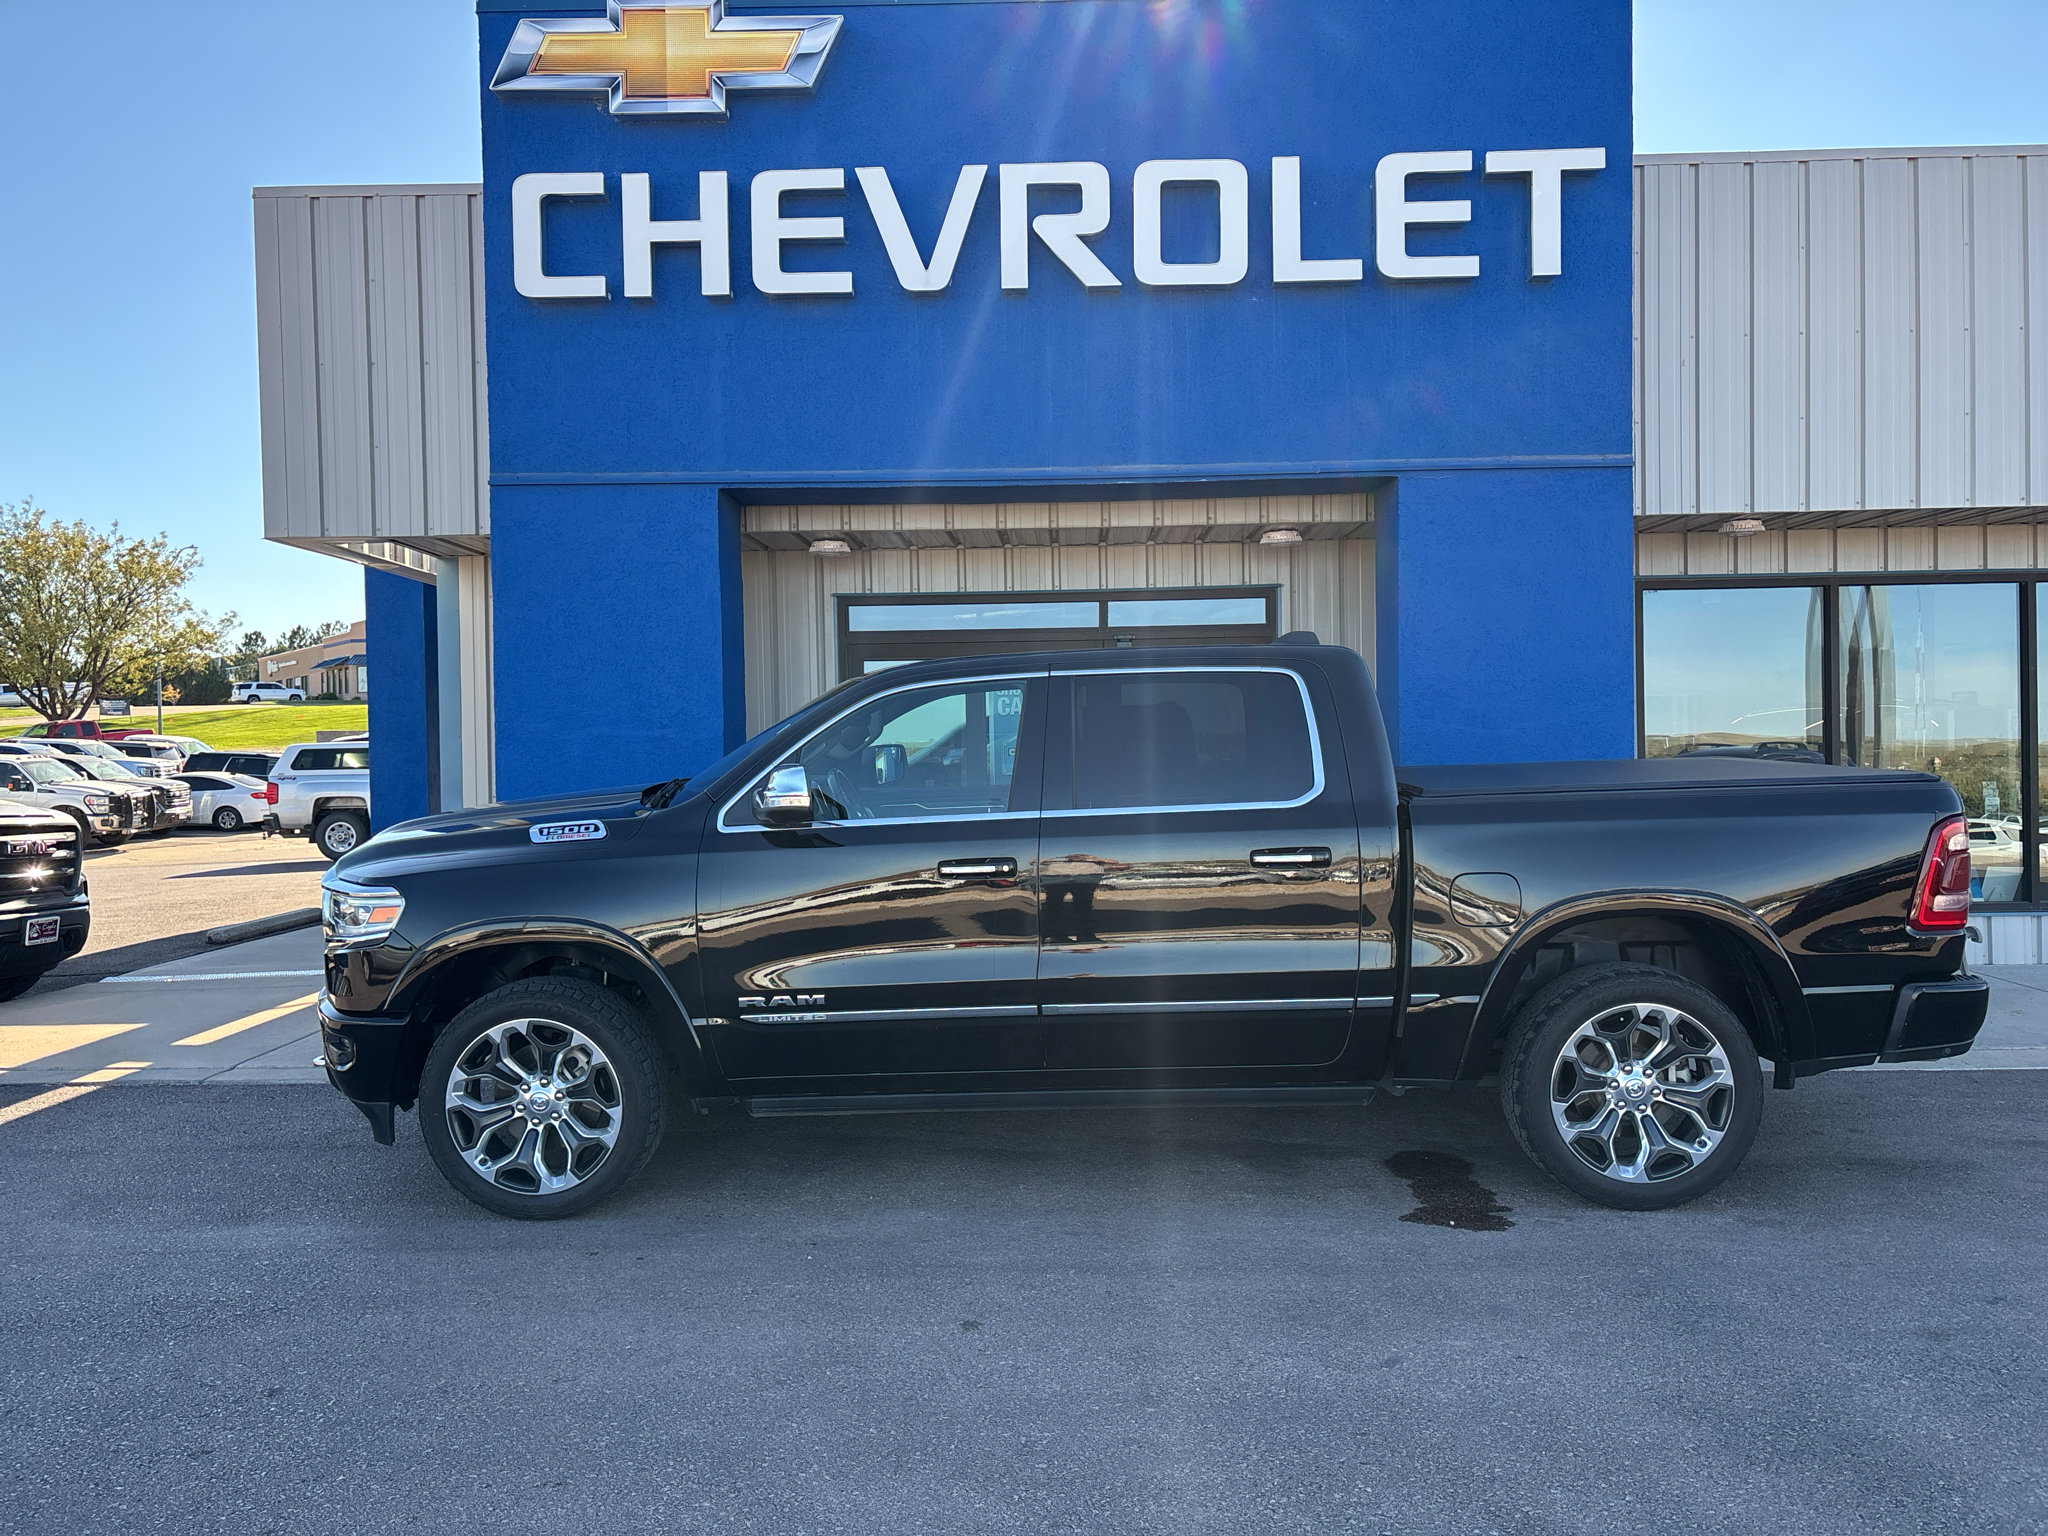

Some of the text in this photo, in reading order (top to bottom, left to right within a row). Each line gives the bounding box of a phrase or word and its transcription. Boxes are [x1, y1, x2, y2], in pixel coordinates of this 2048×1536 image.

[512, 147, 1607, 300] CHEVROLET
[541, 824, 596, 836] 1500
[8, 840, 57, 855] GMC
[738, 994, 826, 1008] RAM
[758, 1014, 827, 1022] LIMITED
